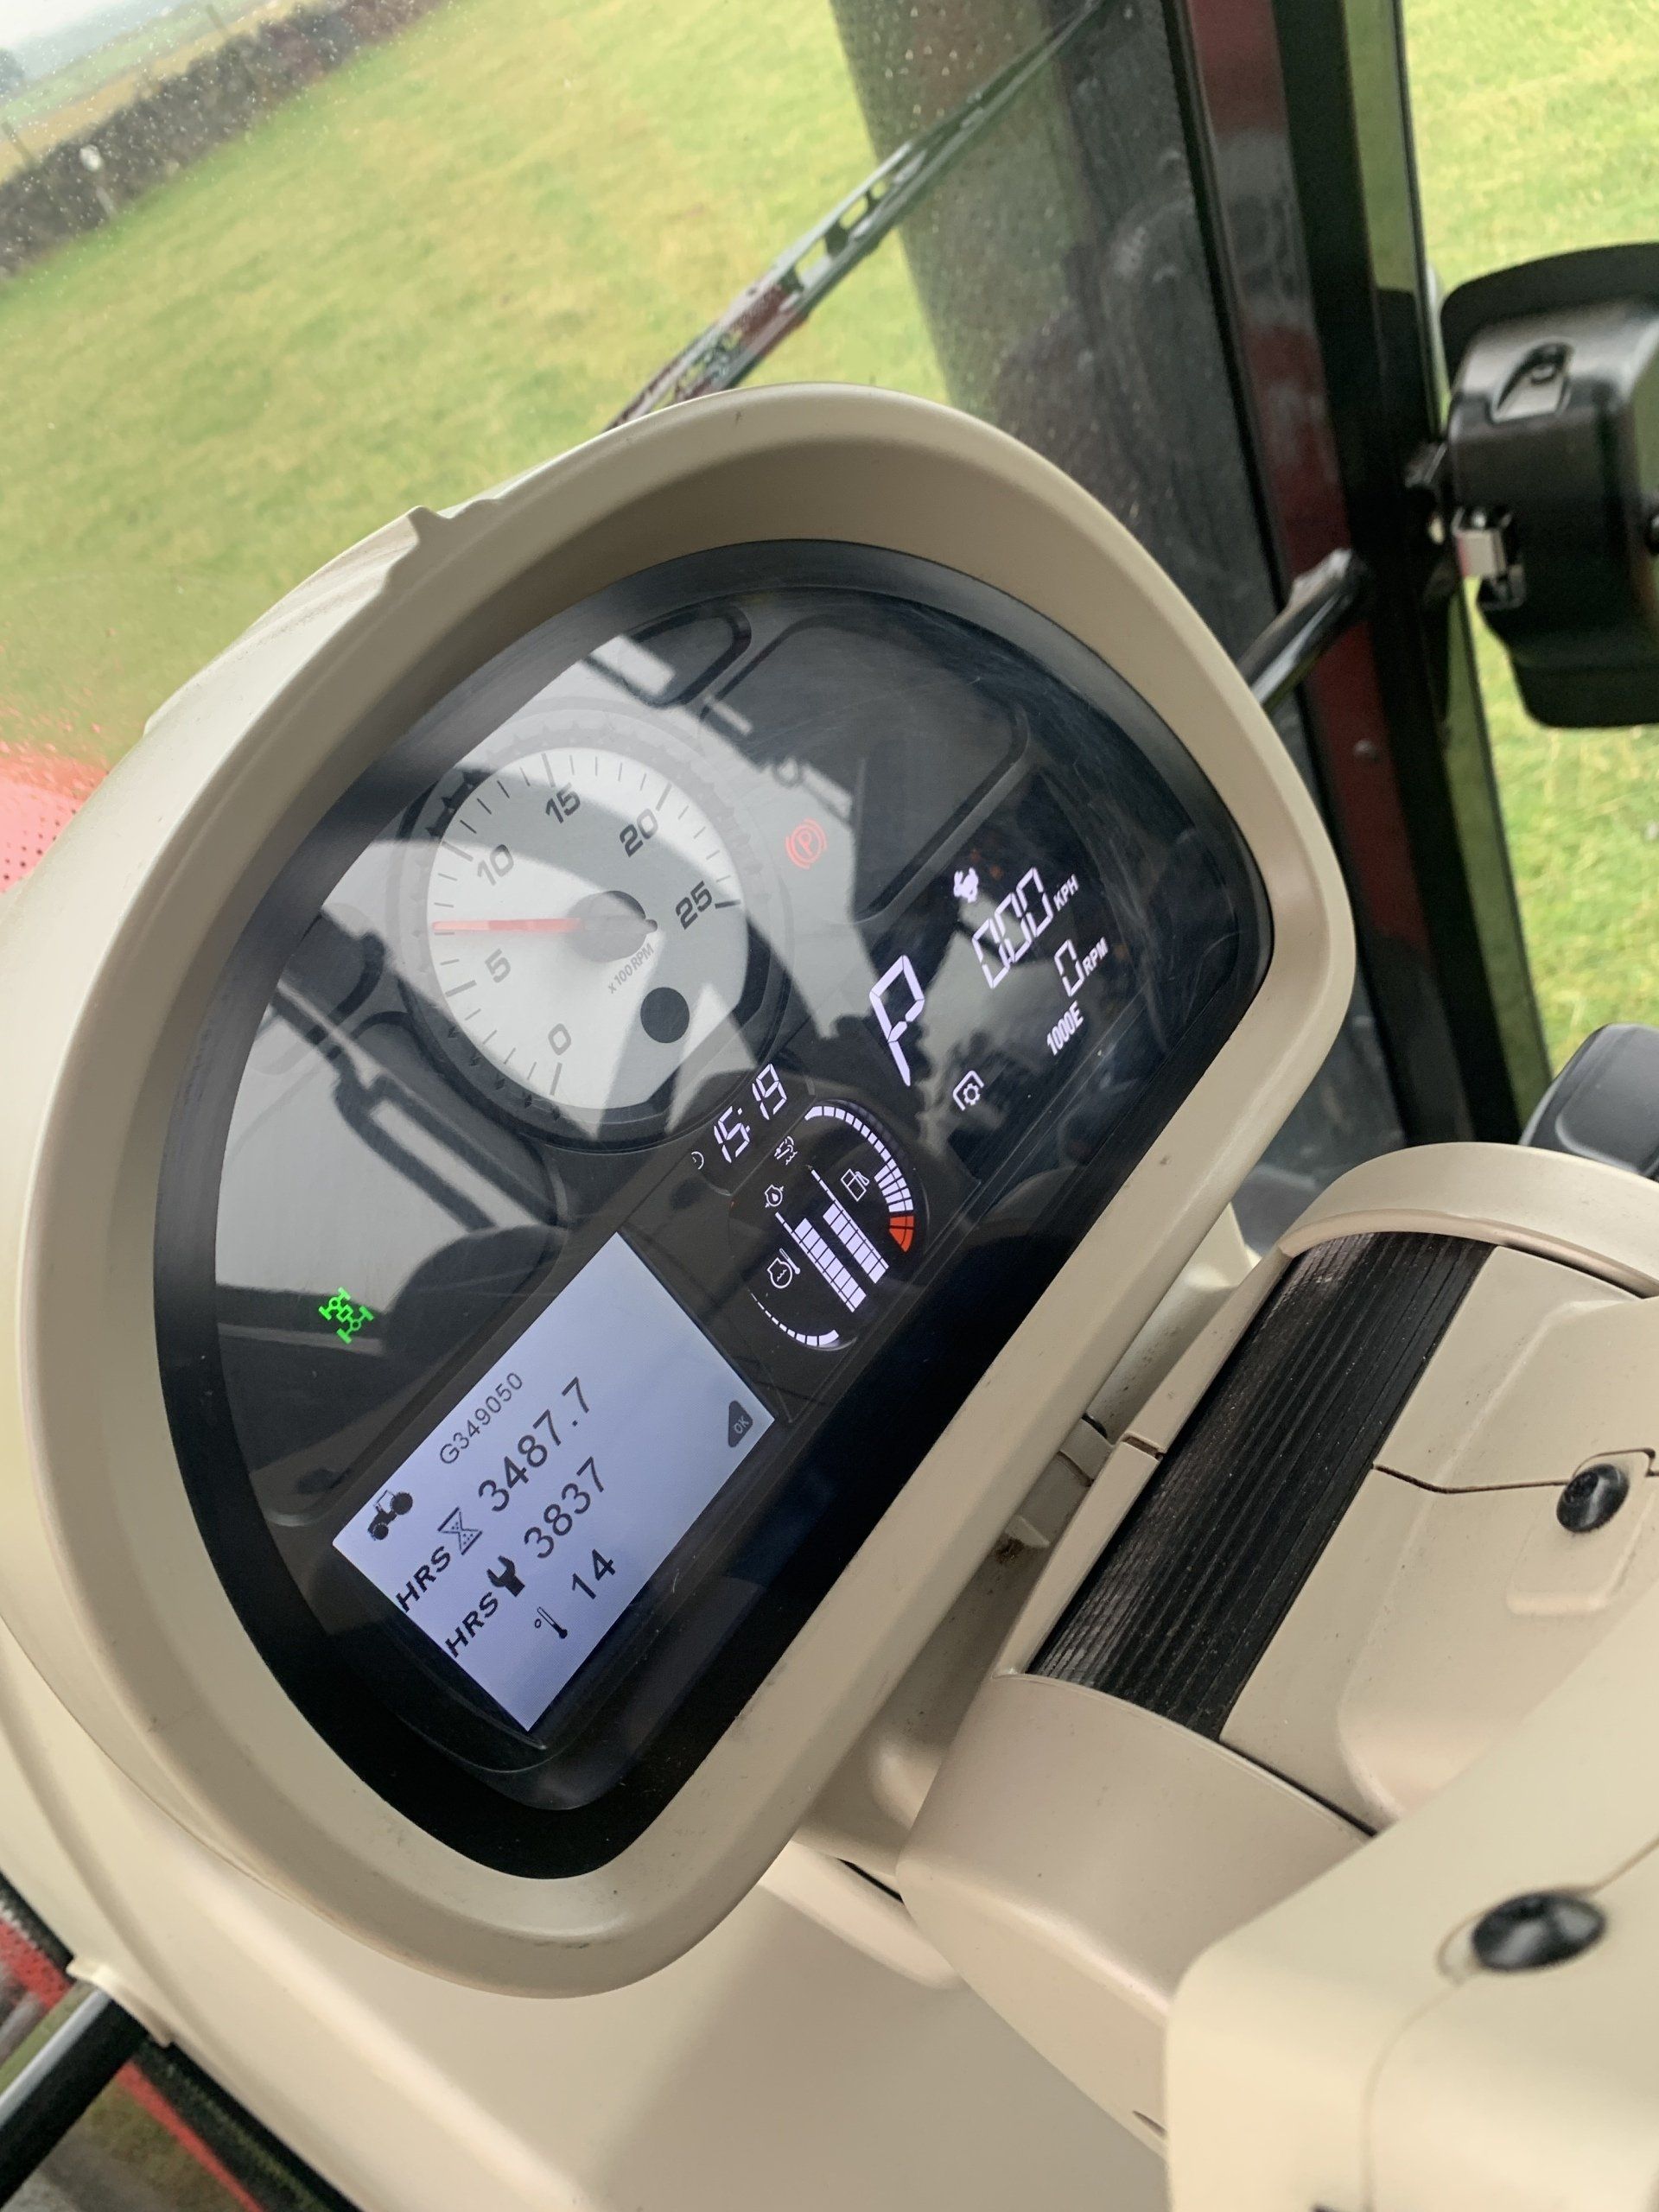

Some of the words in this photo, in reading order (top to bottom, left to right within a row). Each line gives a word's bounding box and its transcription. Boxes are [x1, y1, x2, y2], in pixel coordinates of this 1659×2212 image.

[544, 784, 582, 823] 15
[619, 809, 659, 858] 20
[476, 843, 515, 886] 10
[675, 880, 714, 931] 25
[1053, 873, 1079, 912] KPH
[484, 949, 512, 983] 5
[1053, 938, 1086, 998] 0
[1081, 936, 1109, 977] RPM
[547, 1022, 573, 1057] 0
[869, 954, 925, 1088] P
[1046, 1000, 1084, 1057] 1000E
[713, 1063, 788, 1164] 15:19
[439, 1371, 524, 1465] G349050
[734, 1415, 750, 1435] OK
[395, 1545, 451, 1612] HRS
[478, 1376, 591, 1513] 3487.7
[444, 1590, 499, 1658] HRS
[523, 1455, 607, 1560] 3837
[571, 1548, 615, 1600] 14
